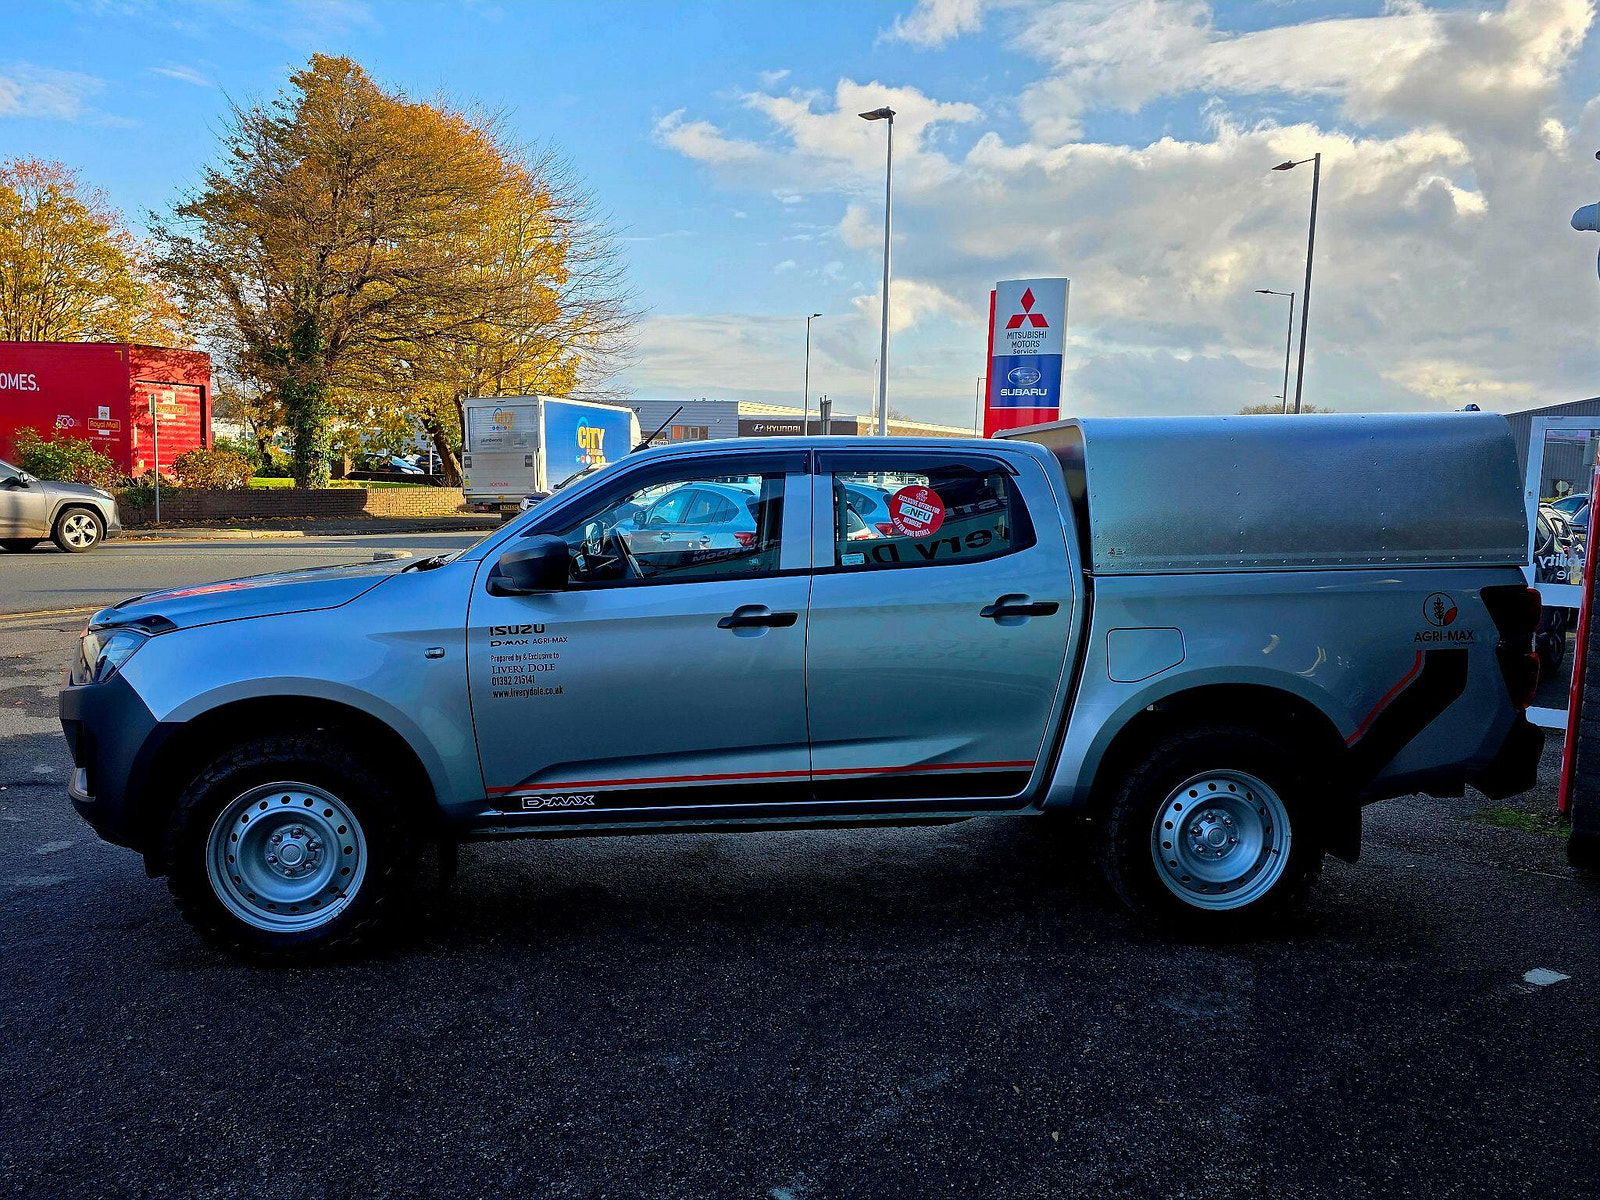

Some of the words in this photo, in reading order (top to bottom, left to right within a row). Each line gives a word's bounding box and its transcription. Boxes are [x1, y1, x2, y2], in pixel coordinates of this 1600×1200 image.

[1006, 331, 1047, 339] MITSUBISHI
[1011, 340, 1041, 348] MOTORS
[1000, 388, 1048, 396] SUBARU
[766, 425, 801, 433] HYUNDAI
[578, 427, 605, 449] CITY
[909, 508, 931, 522] NFU
[489, 623, 545, 636] ISUZU
[532, 636, 568, 645] AGRI-MAX
[1413, 629, 1475, 643] AGRI-MAX
[491, 675, 512, 686] 01392
[493, 686, 564, 698] www.liverydole.co.uk
[522, 795, 595, 809] D-MAX
